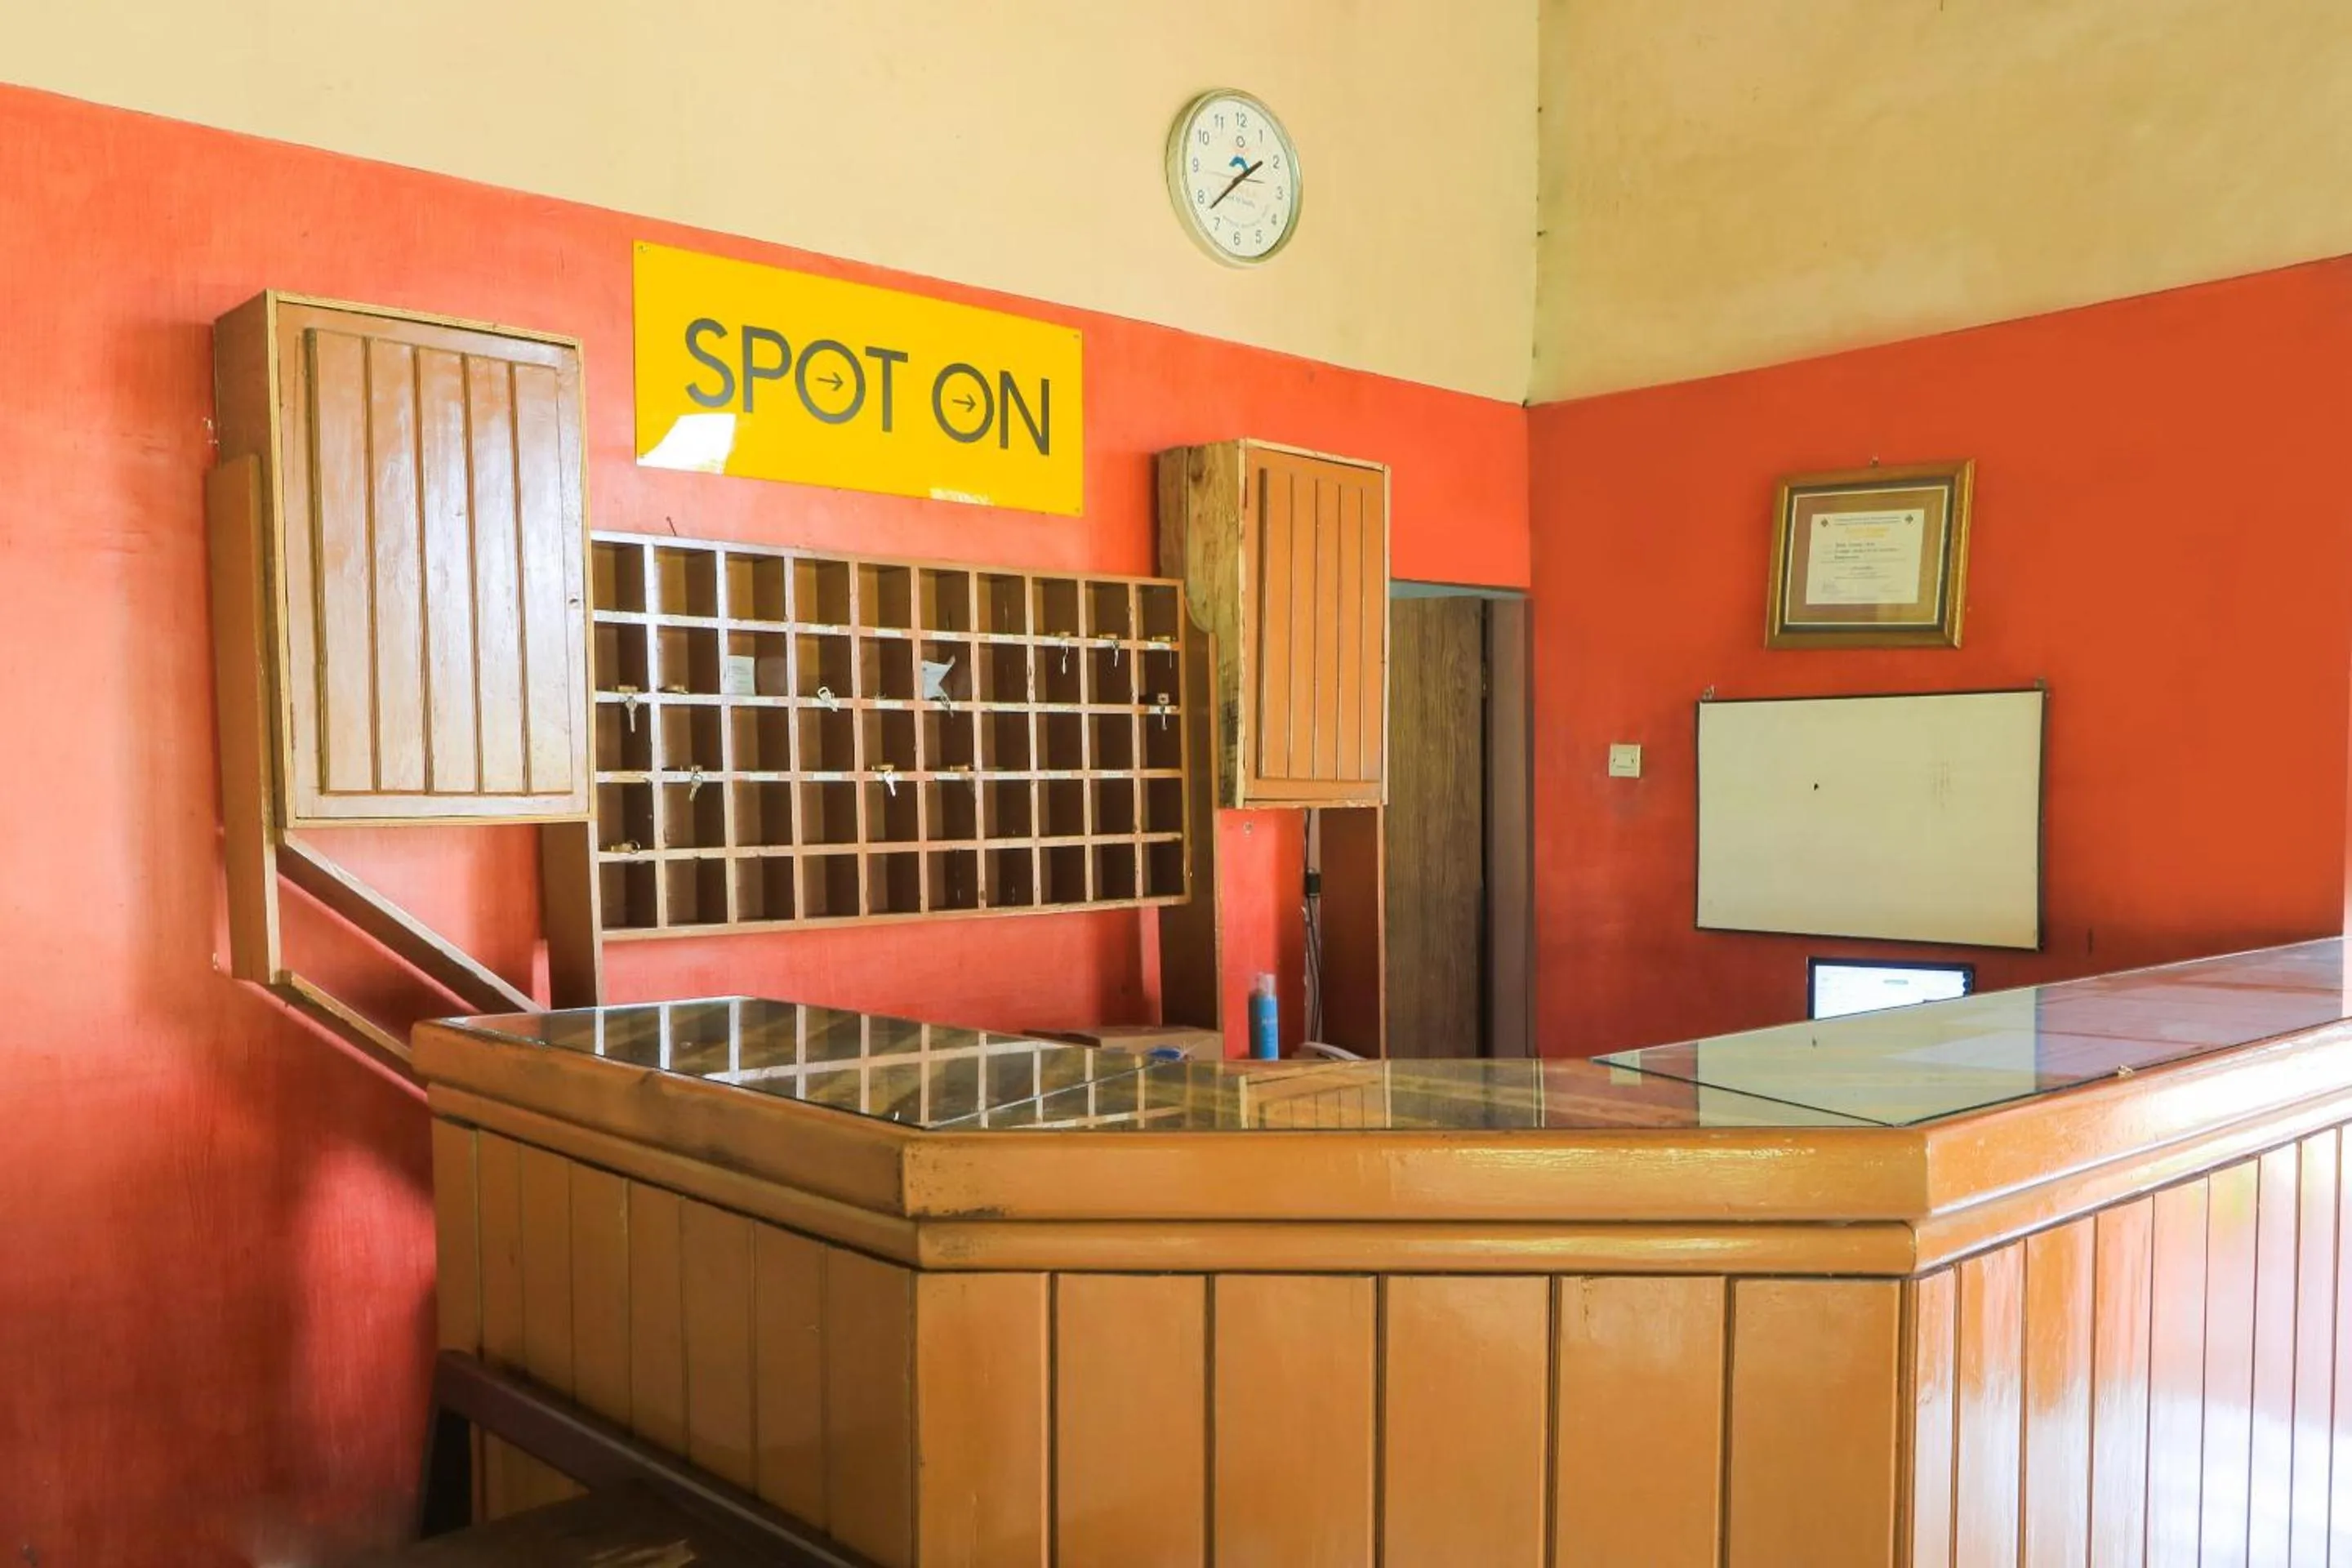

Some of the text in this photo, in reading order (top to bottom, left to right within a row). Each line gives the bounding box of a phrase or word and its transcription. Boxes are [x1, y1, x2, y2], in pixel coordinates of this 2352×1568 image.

[1214, 114, 1224, 129] 11
[1236, 112, 1248, 128] 12
[1198, 130, 1210, 145] 10
[1192, 158, 1199, 172] 9
[1272, 155, 1281, 169] 2
[1197, 189, 1205, 204] 8
[1276, 186, 1283, 200] 3
[1214, 216, 1220, 231] 7
[1271, 213, 1277, 225] 4
[1233, 231, 1241, 245] 6
[1255, 229, 1263, 244] 5
[685, 318, 1050, 456] SPOT ON
